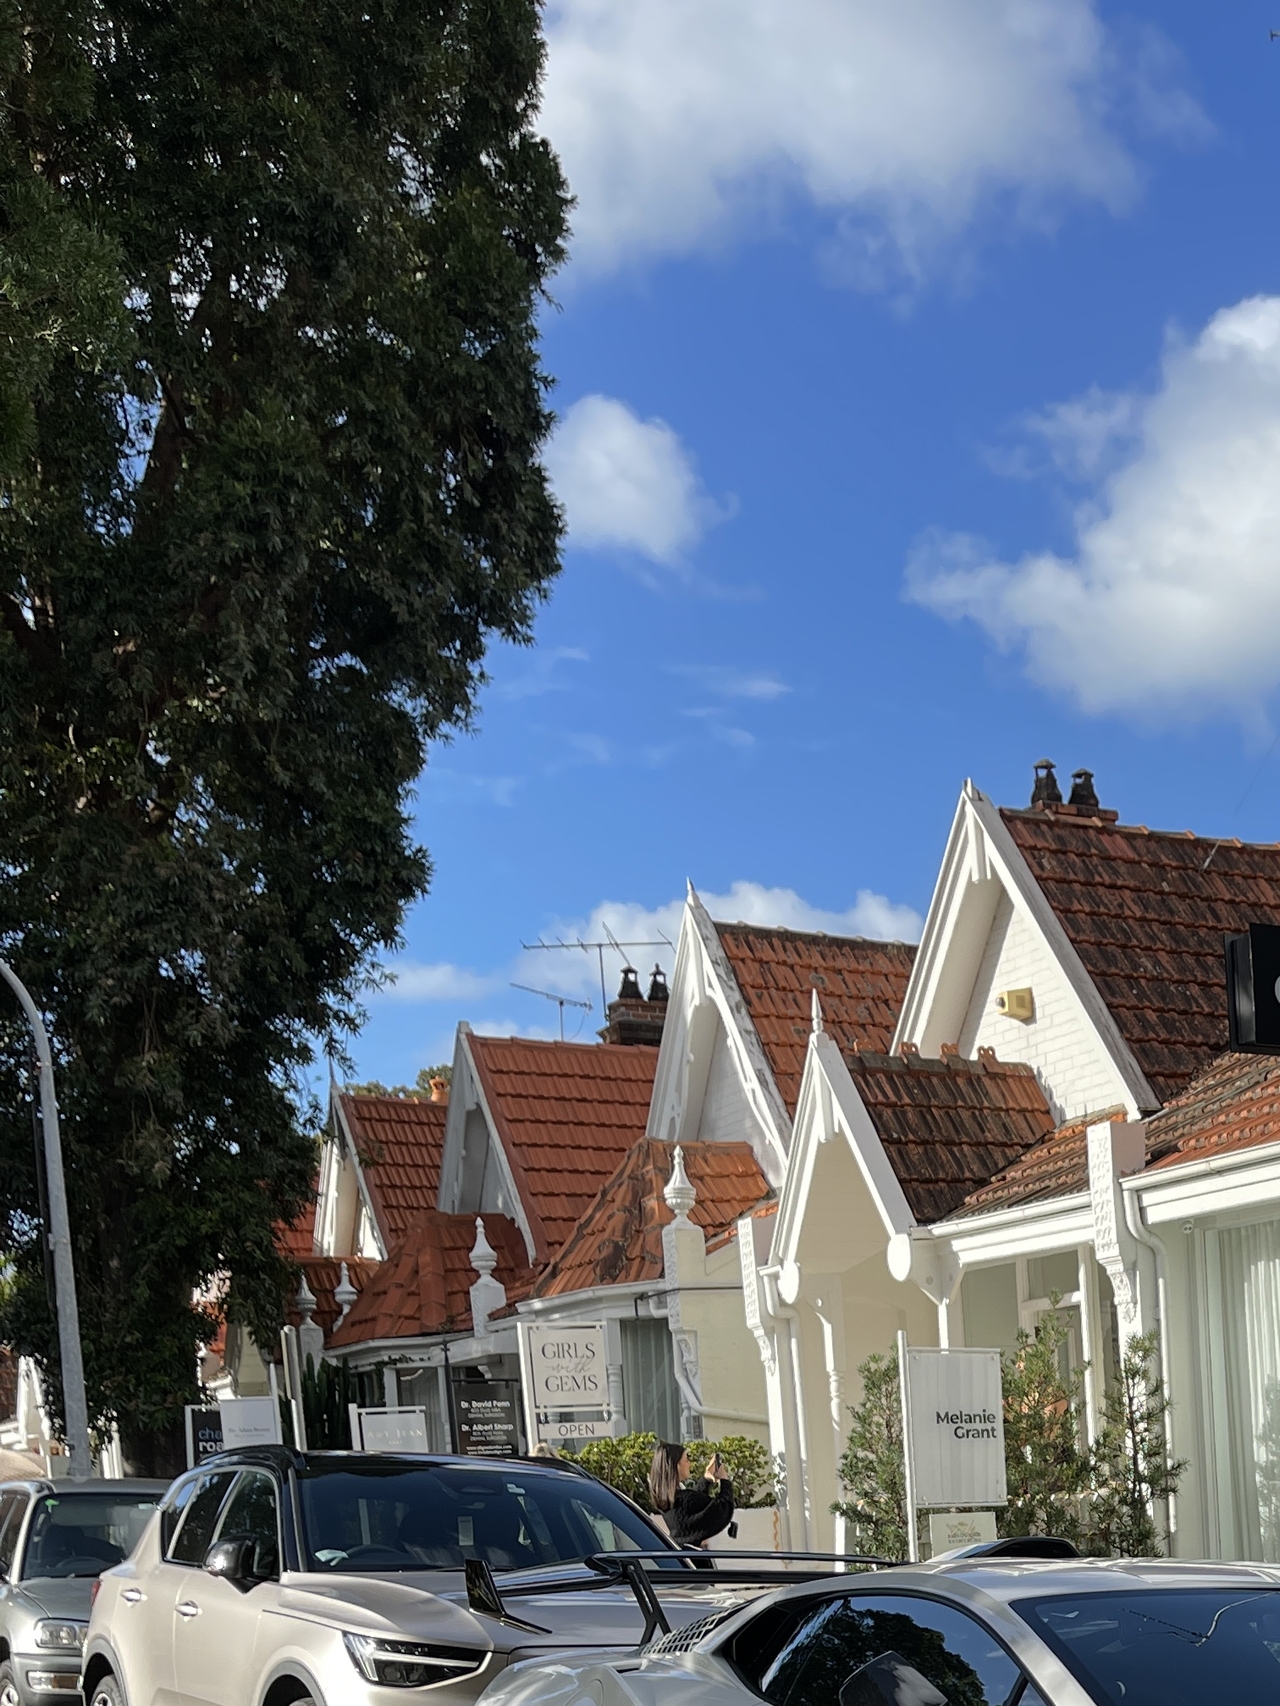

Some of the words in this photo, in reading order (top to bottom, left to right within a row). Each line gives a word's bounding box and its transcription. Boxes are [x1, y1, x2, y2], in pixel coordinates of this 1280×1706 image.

[541, 1342, 596, 1360] GIRLS
[545, 1356, 591, 1374] with
[545, 1374, 598, 1392] GEMS
[460, 1401, 471, 1409] Dr.
[471, 1400, 492, 1408] David
[935, 1409, 996, 1424] Melanie
[461, 1424, 472, 1432] Dr.
[472, 1423, 494, 1431] Albert
[494, 1423, 514, 1431] Sharp
[558, 1424, 595, 1436] OPEN
[953, 1426, 997, 1439] Grant
